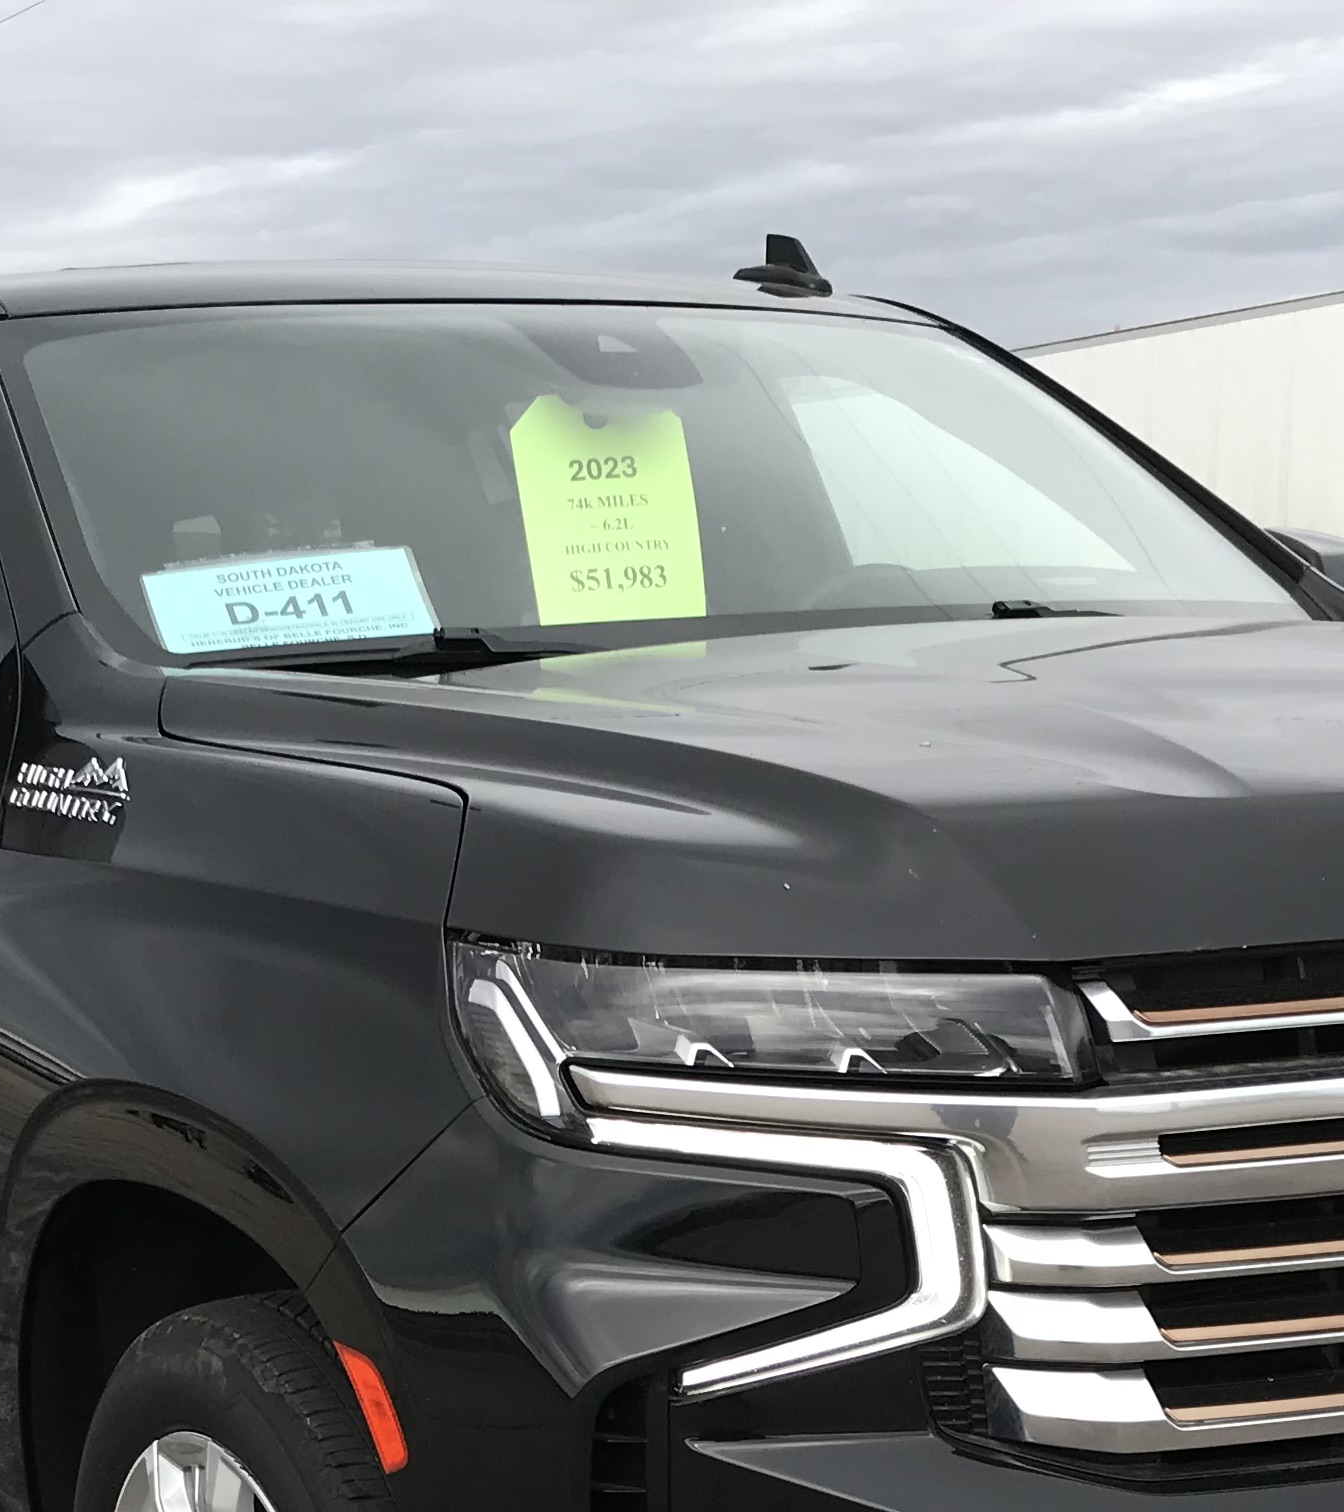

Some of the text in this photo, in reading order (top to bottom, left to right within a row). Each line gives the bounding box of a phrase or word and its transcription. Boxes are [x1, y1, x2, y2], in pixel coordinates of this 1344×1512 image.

[568, 455, 638, 482] 2023
[567, 493, 649, 511] 74k MILES
[602, 517, 634, 532] 6.2L
[605, 539, 671, 554] COUNTRY
[216, 560, 343, 584] SOUTH DAKOTA
[569, 564, 668, 593] $51,983
[214, 574, 353, 598] VEHICLE DEALER
[224, 590, 354, 626] D-411
[17, 762, 75, 790] HIGH
[9, 787, 123, 825] COUNTRY
